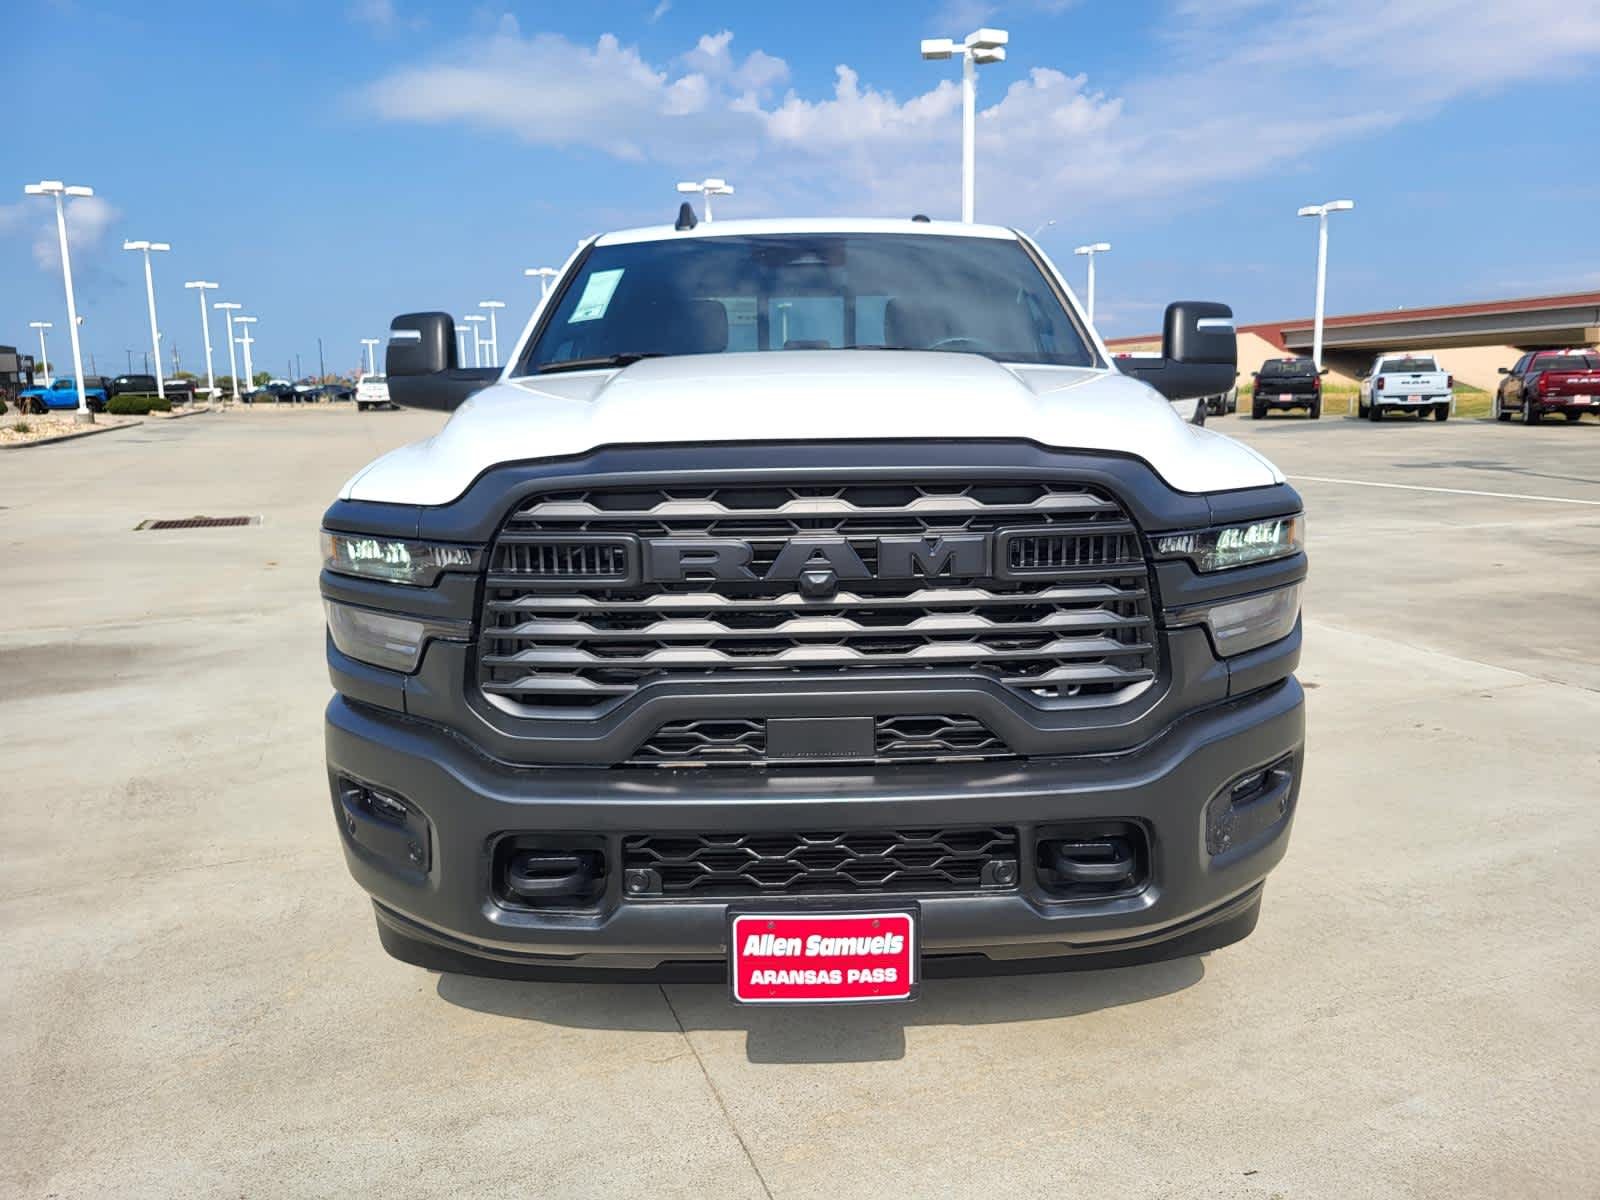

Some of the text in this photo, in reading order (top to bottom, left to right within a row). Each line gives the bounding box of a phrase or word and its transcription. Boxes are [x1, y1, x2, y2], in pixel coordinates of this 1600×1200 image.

[645, 536, 991, 583] RAM
[743, 932, 904, 957] Allen Samuels
[750, 968, 897, 985] ARANSAS PASS
